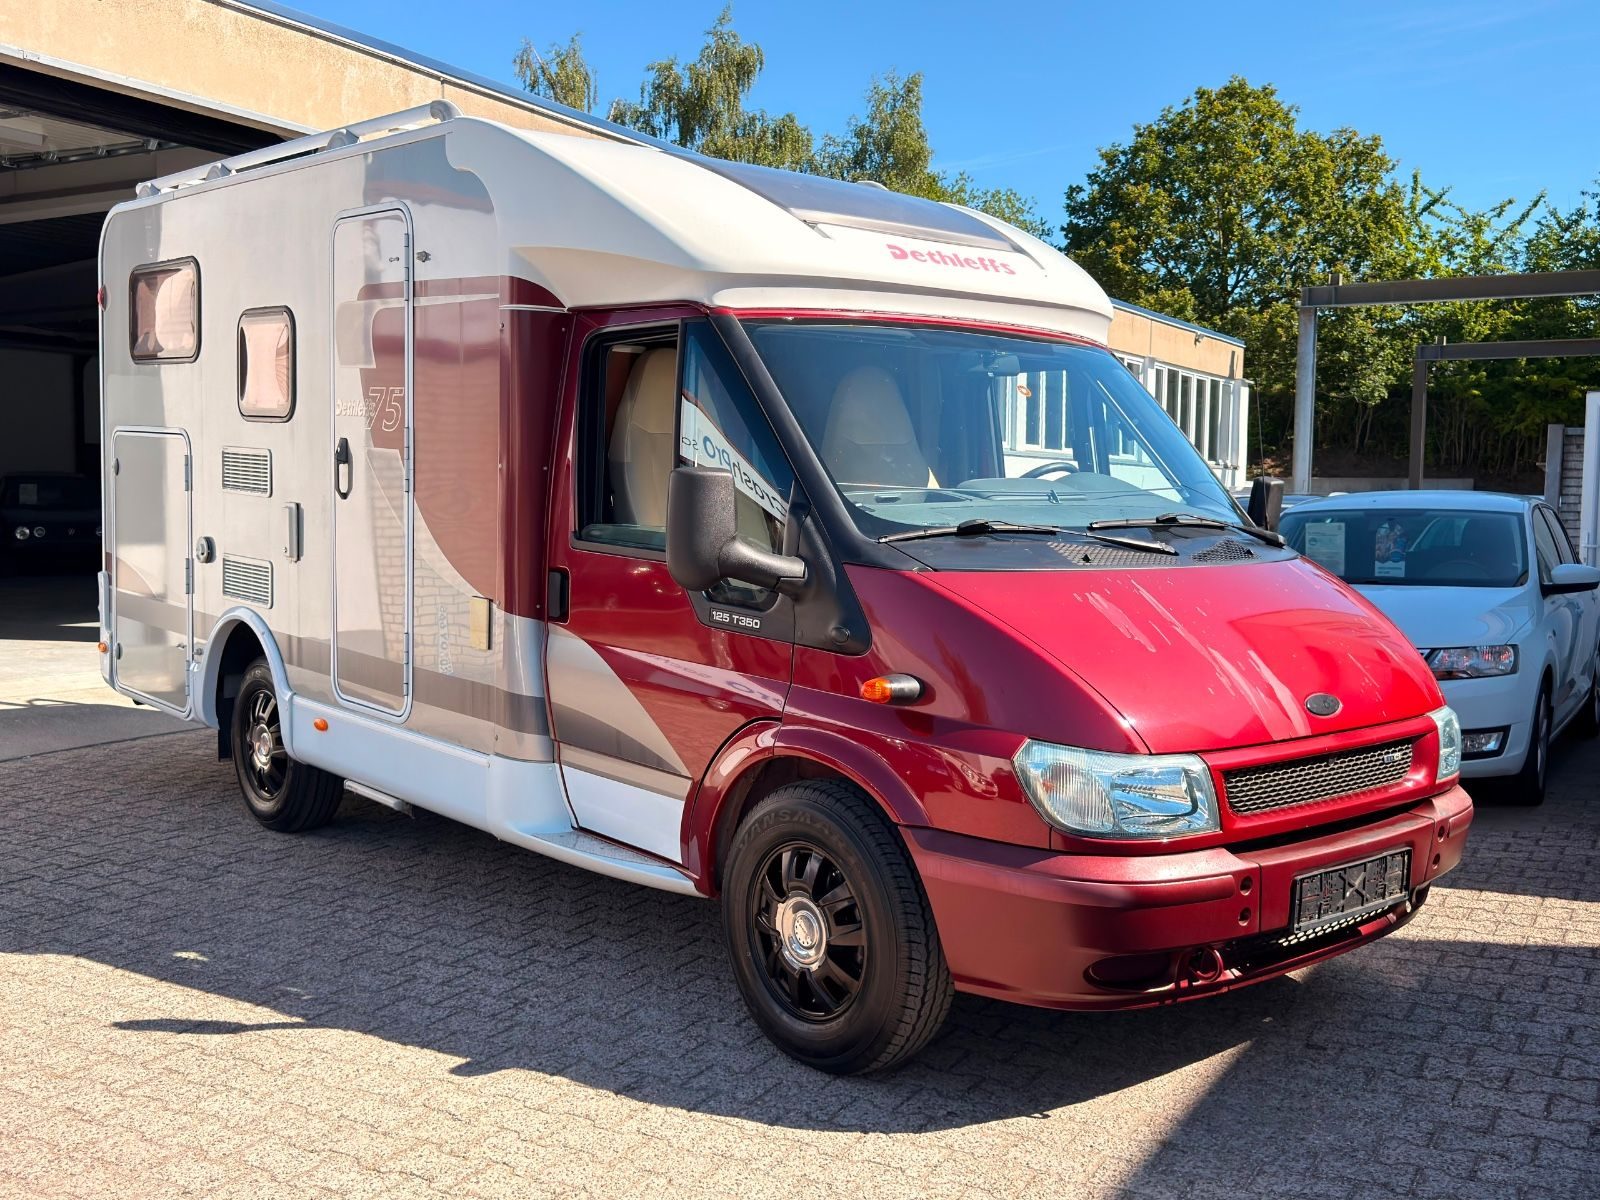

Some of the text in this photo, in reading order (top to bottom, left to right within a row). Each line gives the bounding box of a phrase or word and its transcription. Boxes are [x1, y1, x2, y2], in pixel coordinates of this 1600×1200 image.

[886, 243, 1016, 275] Dethleffs
[364, 386, 405, 432] 75
[712, 610, 760, 629] 125 T350
